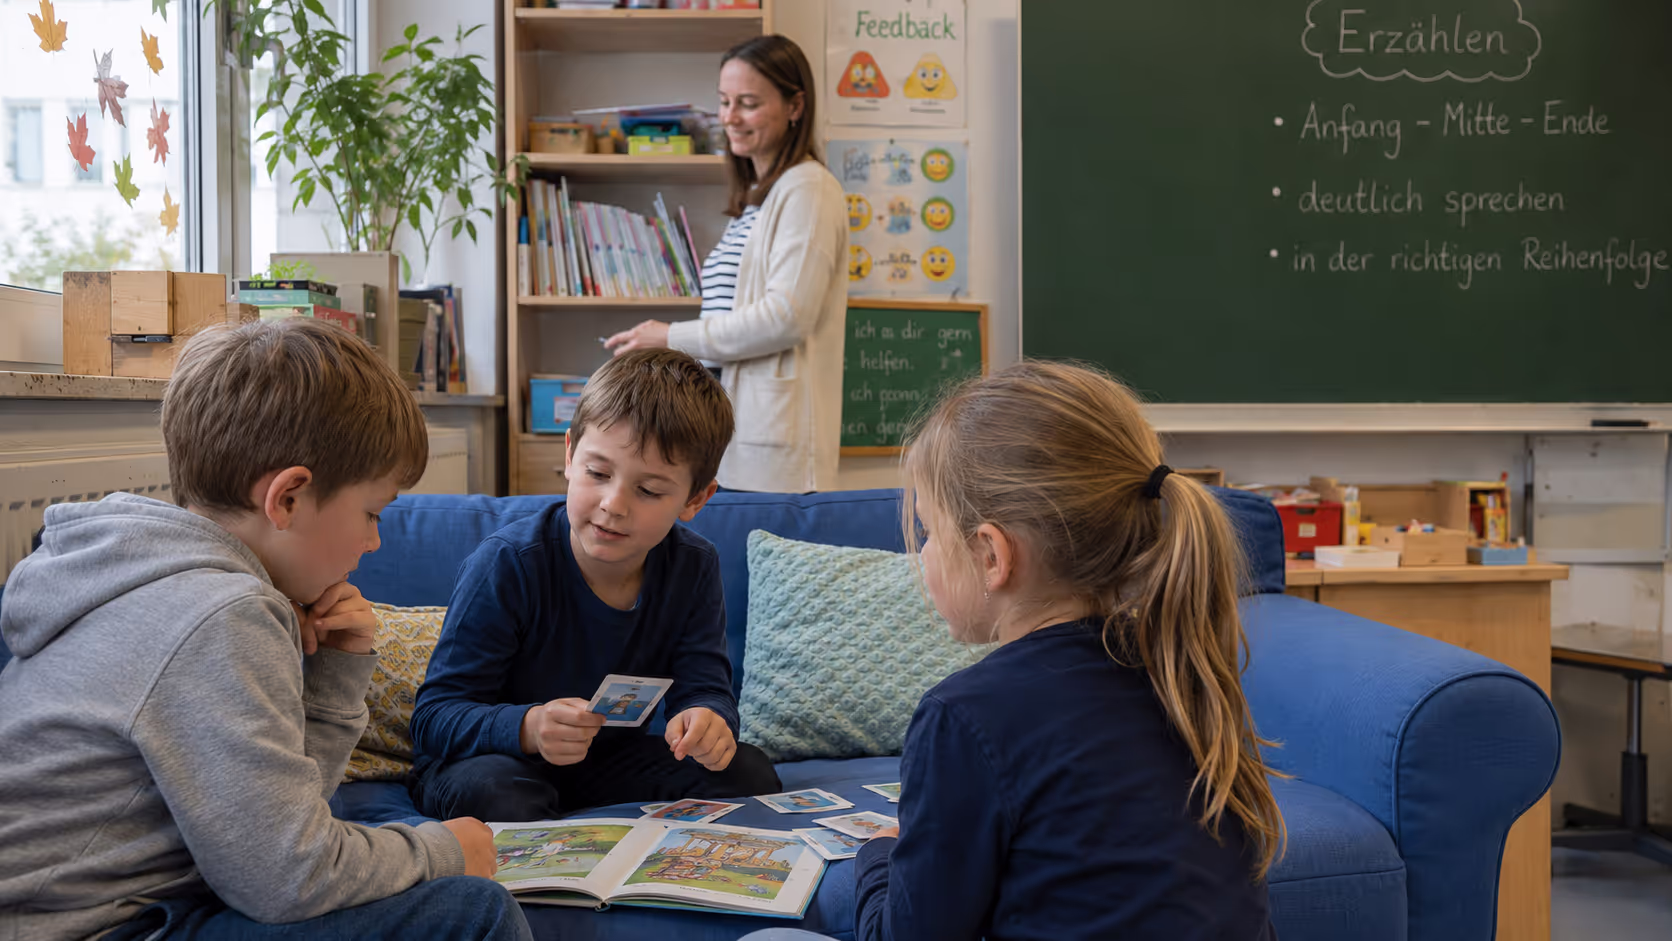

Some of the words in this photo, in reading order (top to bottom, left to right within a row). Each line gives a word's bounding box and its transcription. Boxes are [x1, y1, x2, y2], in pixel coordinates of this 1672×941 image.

[855, 11, 956, 40] Feedback
[1338, 9, 1509, 54] Erzählen
[1300, 101, 1402, 160] Anfang
[1442, 101, 1511, 137] Mitte
[1543, 100, 1611, 135] Ende
[1298, 179, 1423, 214] deutlich
[1445, 181, 1564, 227] sprechen
[1294, 244, 1316, 272] in
[1328, 240, 1373, 272] der
[1390, 239, 1502, 290] richtigen
[1522, 237, 1670, 290] Reihenfolge
[900, 319, 925, 339] dir
[937, 328, 973, 349] gern
